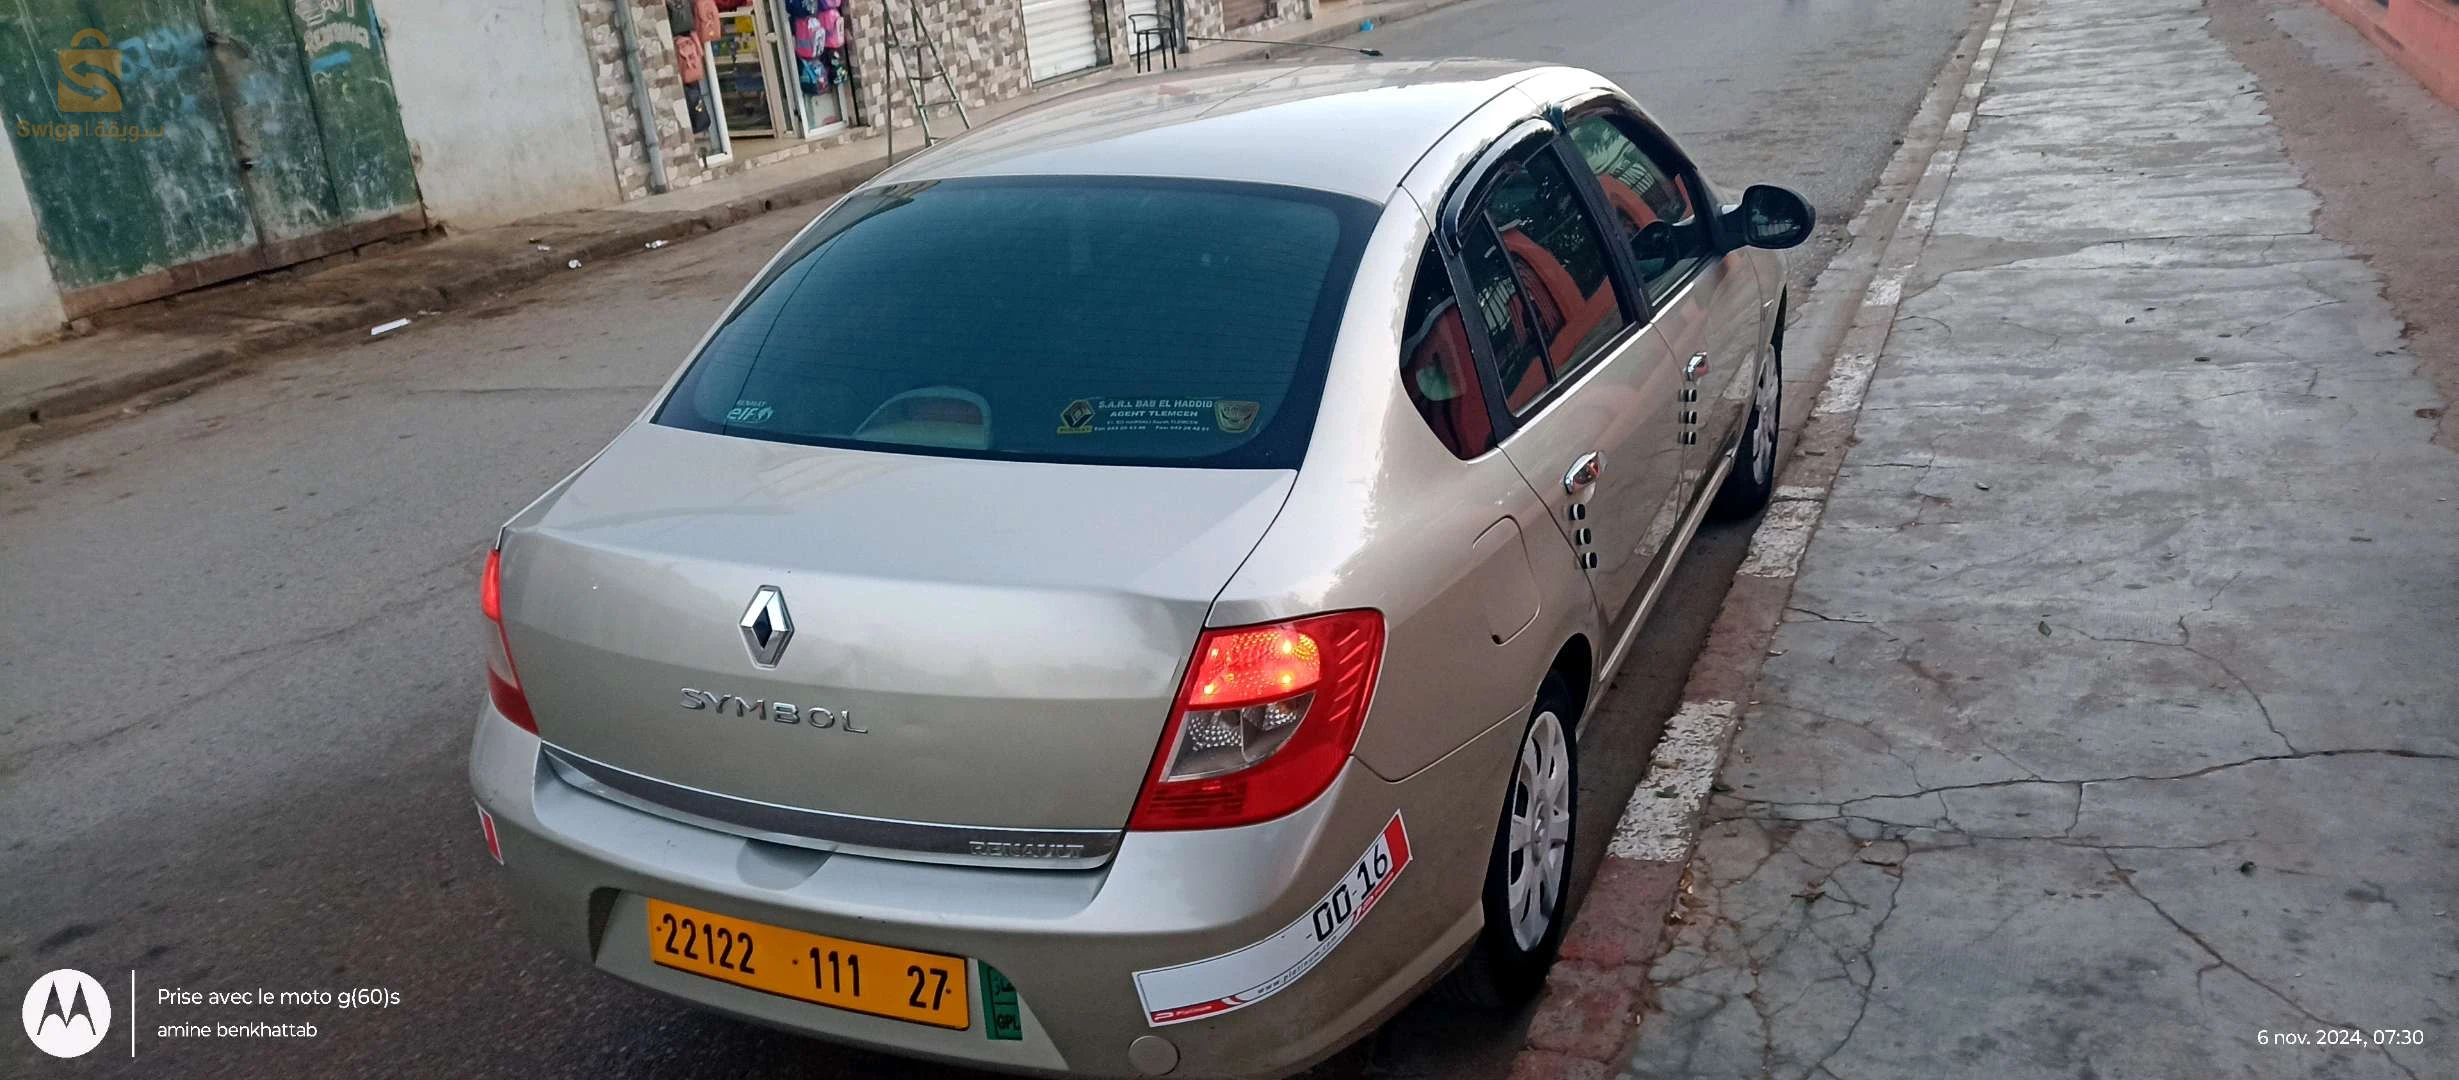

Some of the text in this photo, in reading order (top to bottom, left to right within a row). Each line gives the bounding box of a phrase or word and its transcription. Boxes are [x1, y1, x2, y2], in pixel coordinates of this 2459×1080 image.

[1159, 400, 1172, 409] EL
[727, 407, 759, 420] elf
[1148, 410, 1199, 418] TLEMCEN
[680, 687, 868, 734] SYMBOL
[968, 841, 1085, 859] RENAULT
[662, 913, 756, 975] 22122
[809, 946, 861, 998] 111
[906, 964, 949, 1011] 27
